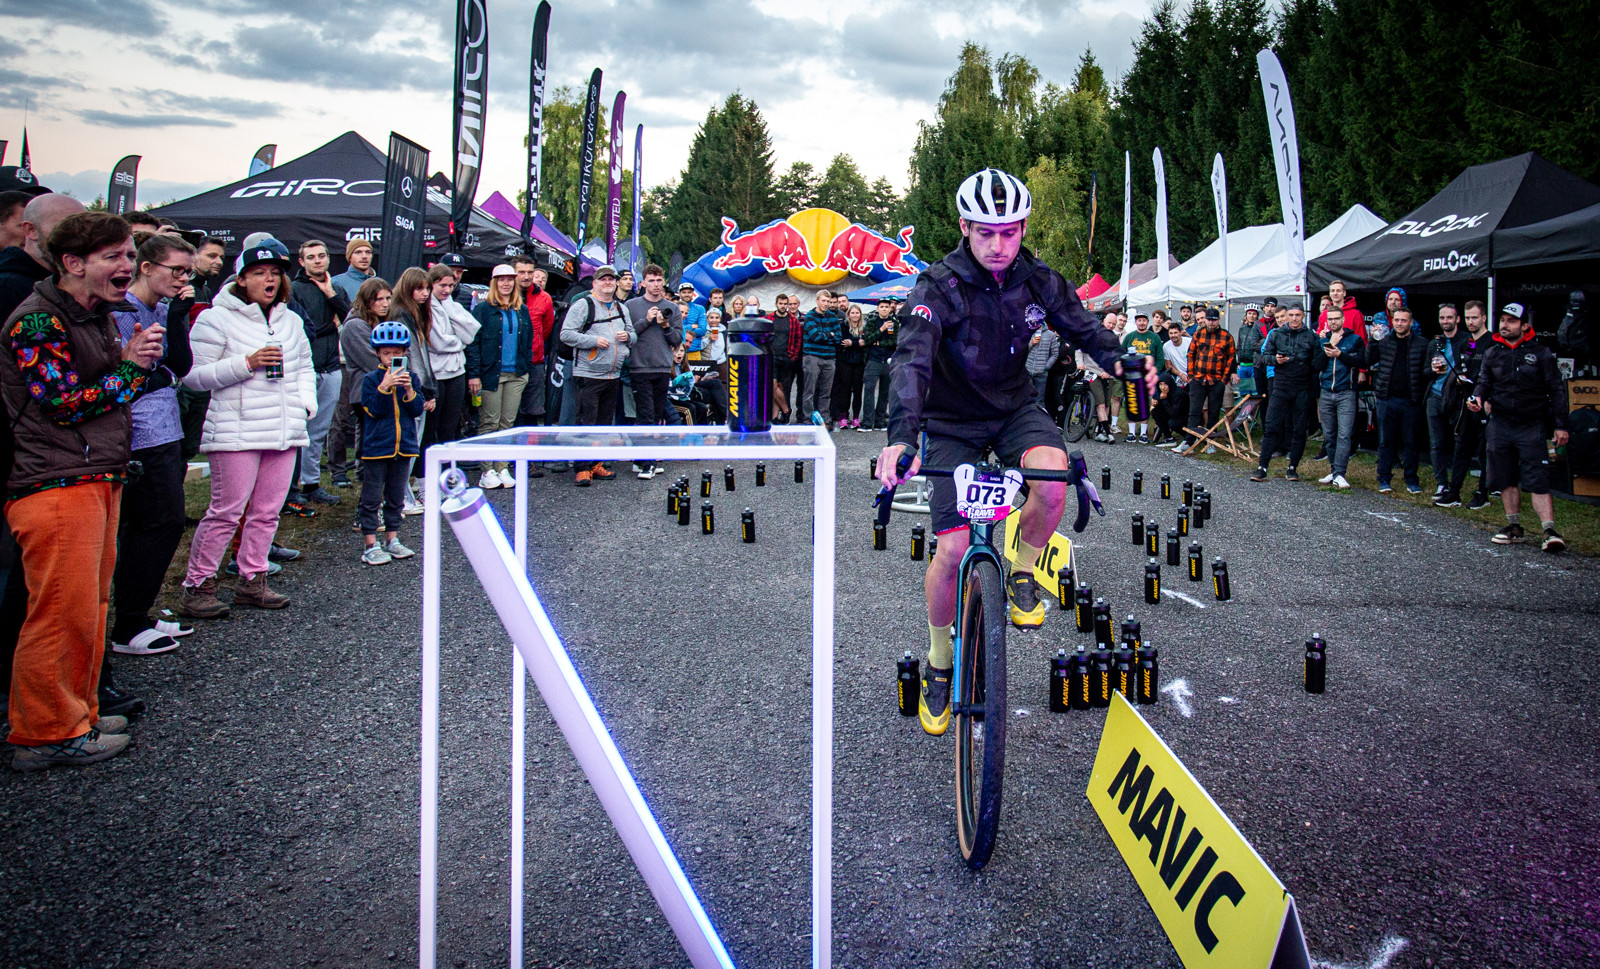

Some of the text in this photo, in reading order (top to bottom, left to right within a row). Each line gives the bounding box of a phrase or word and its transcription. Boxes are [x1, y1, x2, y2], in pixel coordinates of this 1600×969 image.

[345, 227, 382, 241] GIR
[395, 215, 415, 231] SAGA
[1423, 250, 1478, 272] FIDLOCK
[729, 357, 739, 418] MAVIC
[1125, 380, 1139, 415] MAVIC
[966, 484, 1007, 505] 073
[1143, 668, 1151, 698] MAVIC
[1107, 747, 1246, 955] MAVIC
